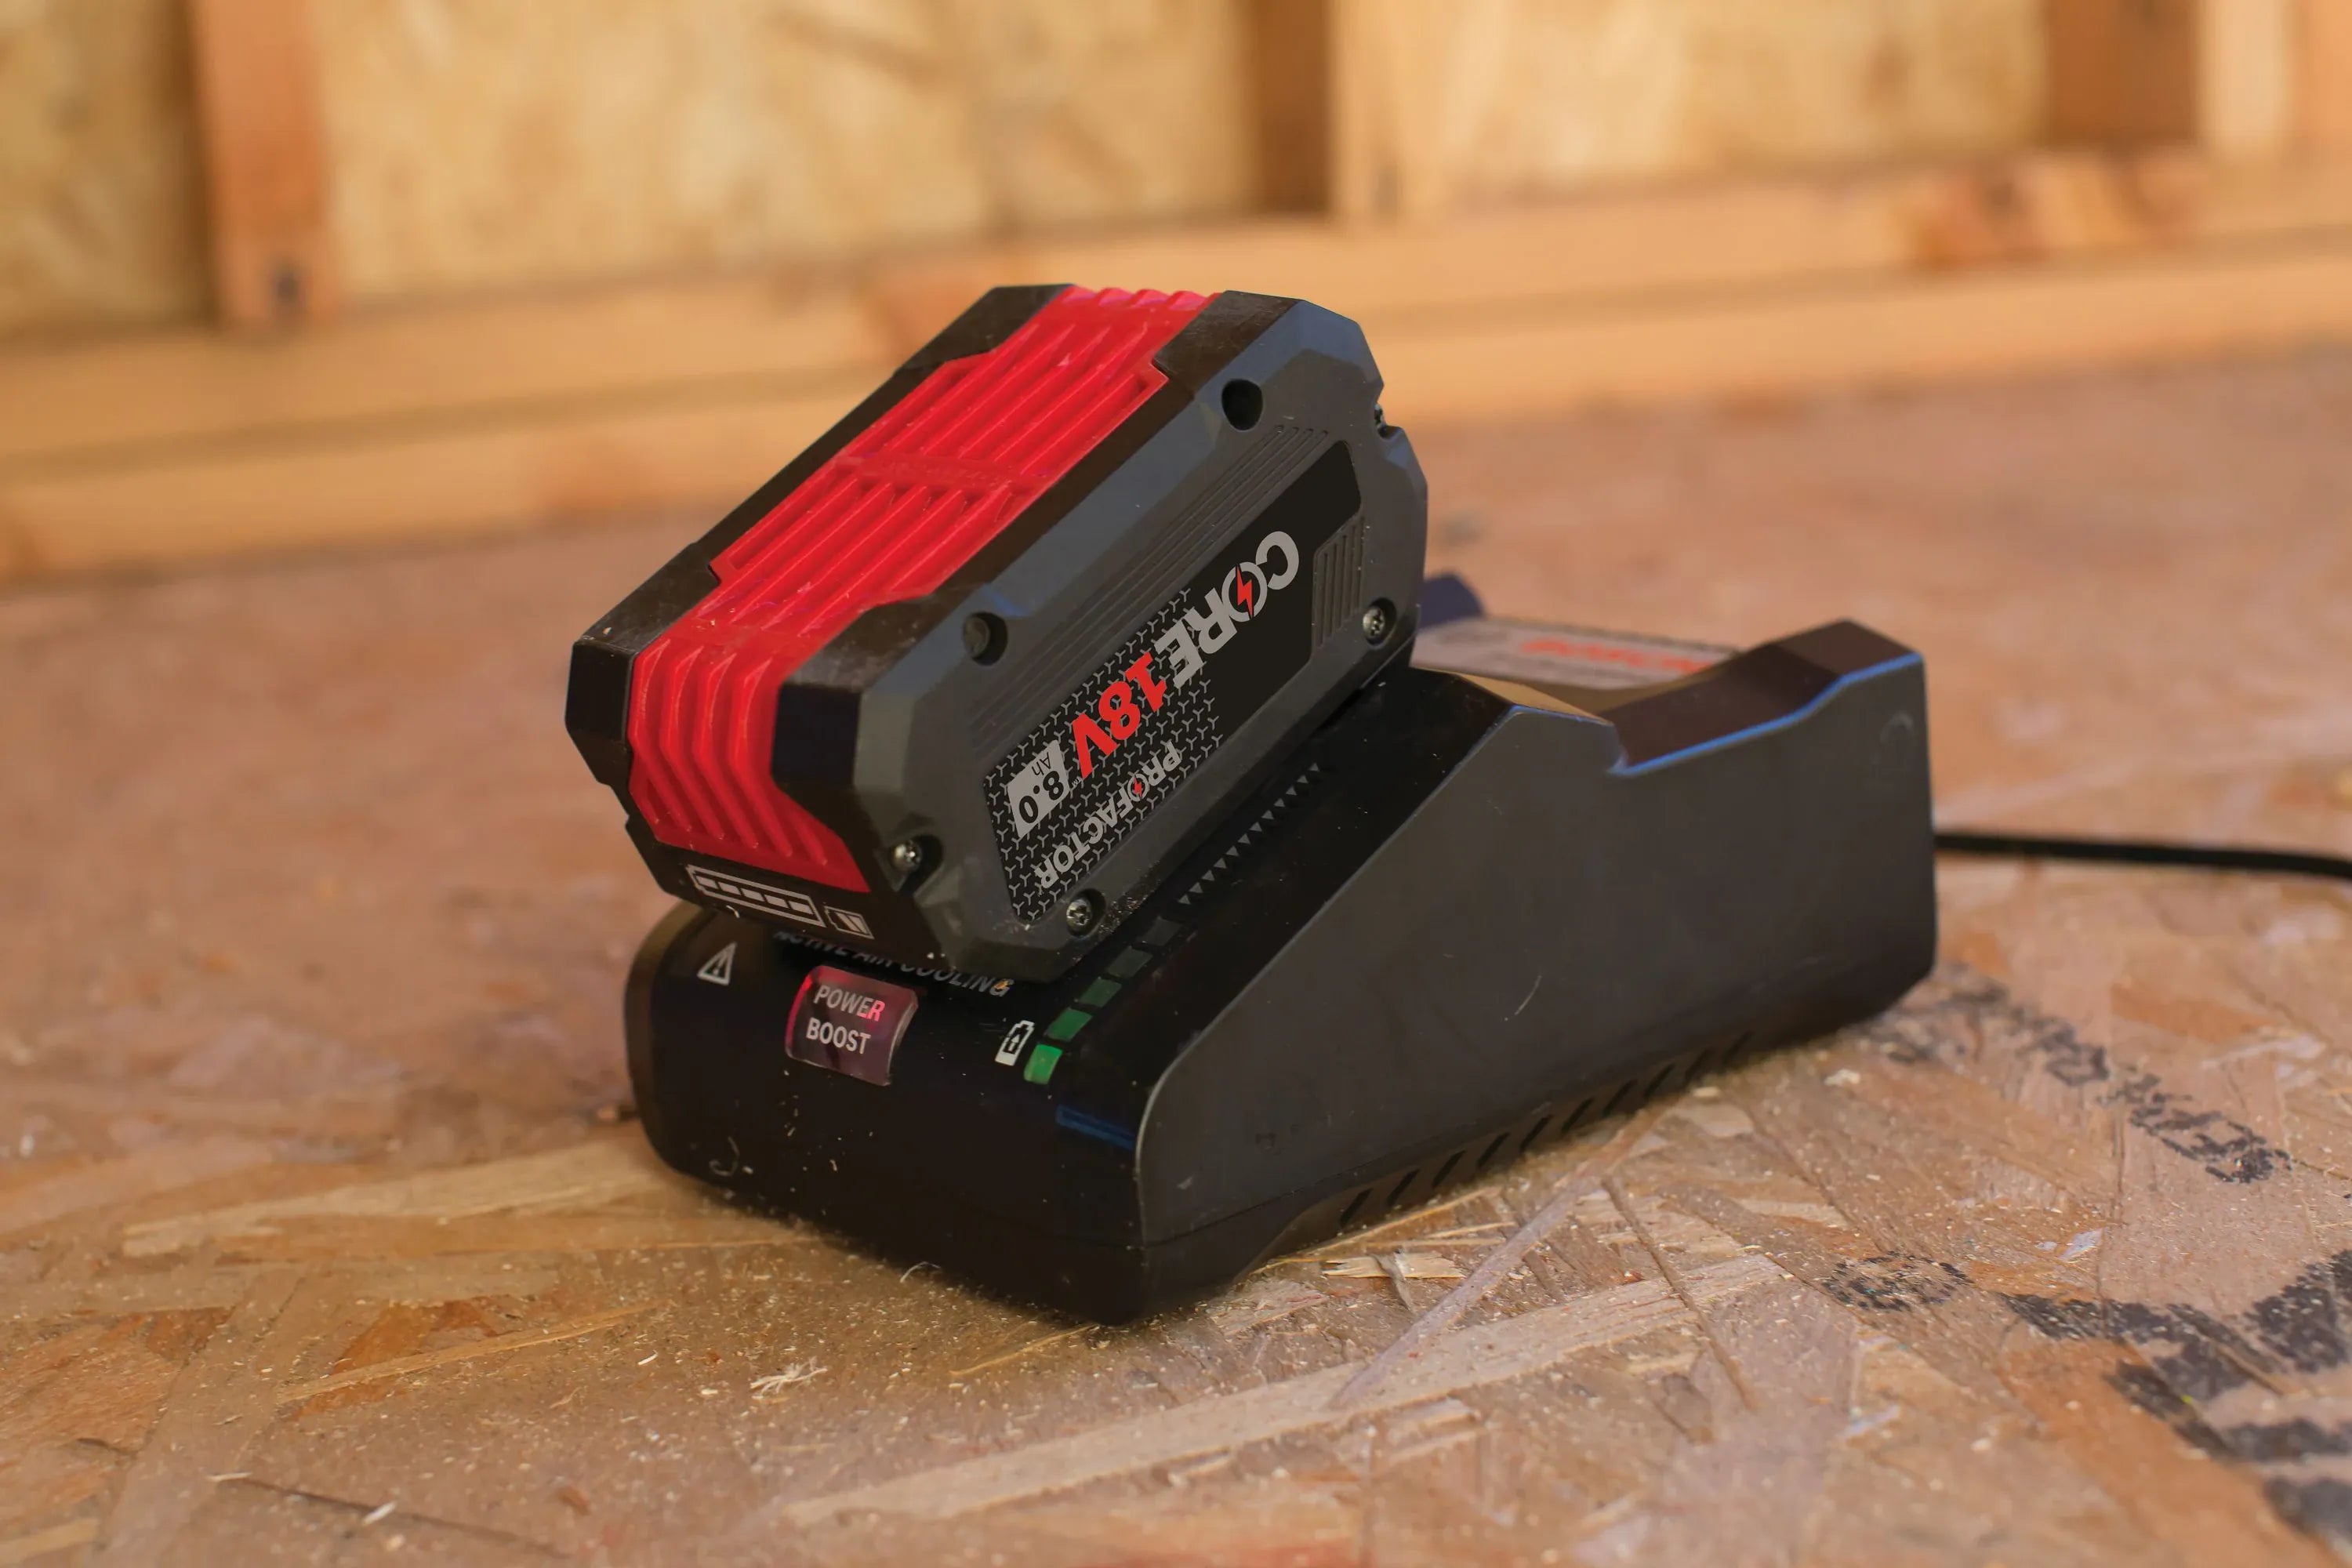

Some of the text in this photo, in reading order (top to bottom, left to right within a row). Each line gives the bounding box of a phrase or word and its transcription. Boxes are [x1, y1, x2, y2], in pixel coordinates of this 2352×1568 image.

[1032, 751, 1051, 776] Ah
[1019, 771, 1064, 823] 8.0
[1034, 739, 1182, 888] PROFACTOR
[813, 985, 886, 1022] POWER
[806, 1018, 872, 1054] BOOST
